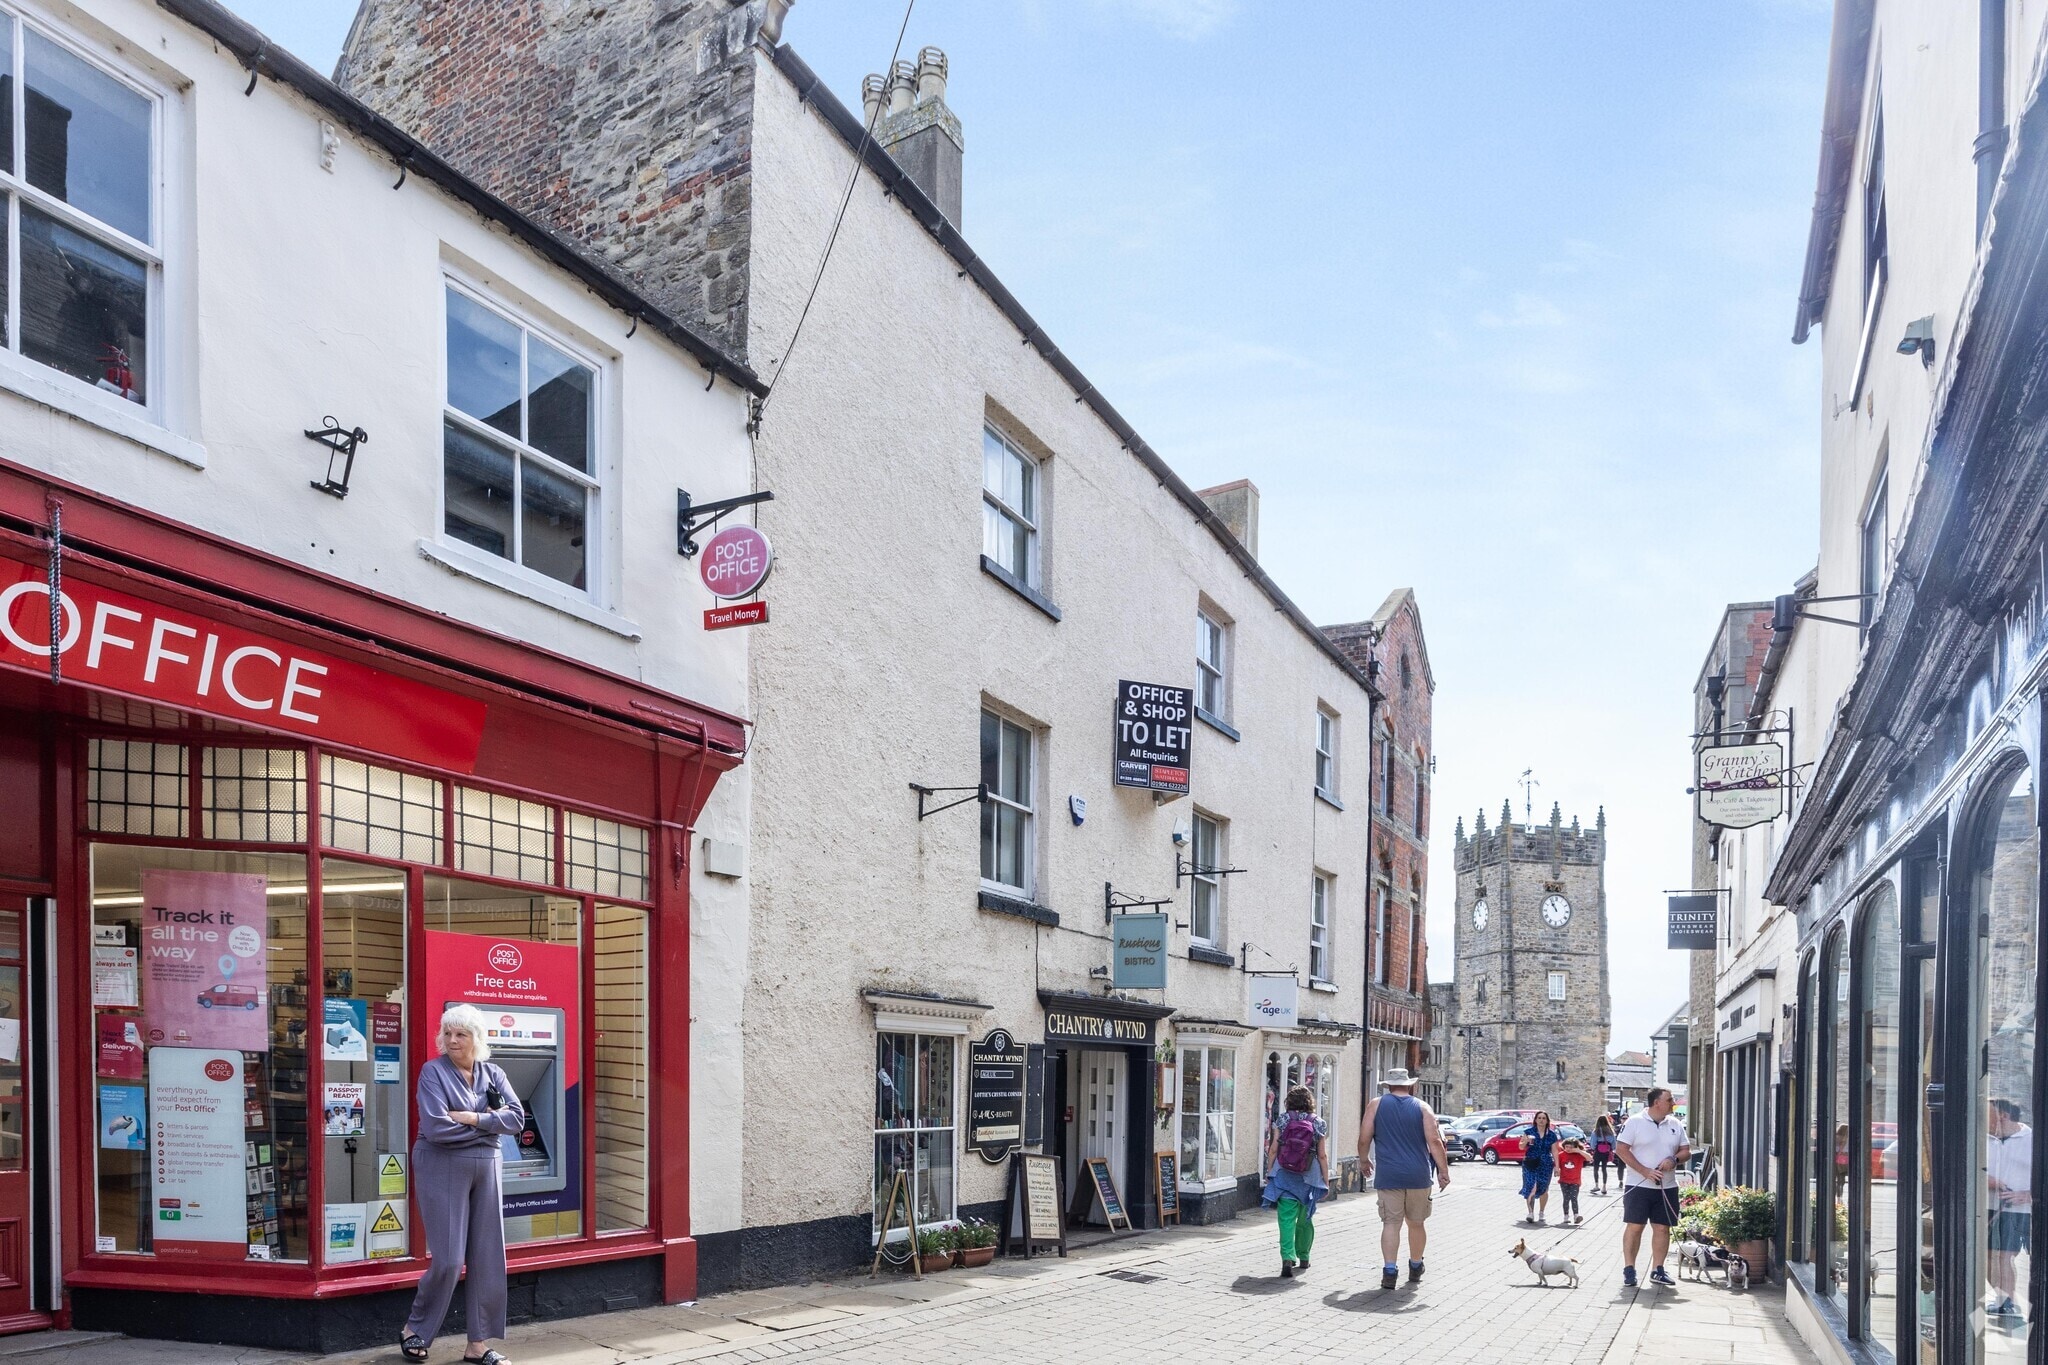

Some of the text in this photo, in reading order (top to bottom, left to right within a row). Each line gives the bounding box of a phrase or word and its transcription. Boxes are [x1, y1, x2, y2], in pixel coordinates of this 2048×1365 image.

[716, 539, 753, 562] POST
[707, 556, 759, 581] OFFICE
[710, 608, 760, 624] Travel Money
[0, 581, 328, 724] OFFICE
[1128, 684, 1184, 705] OFFICE
[1124, 700, 1186, 721] & SHOP
[1119, 720, 1190, 750] TO LET
[1130, 748, 1178, 762] All Enquiries
[1704, 750, 1770, 771] Granny's
[1721, 764, 1778, 781] Kitchen
[152, 907, 234, 925] Track it
[151, 926, 219, 942] all the
[1119, 937, 1162, 952] Rustique
[151, 946, 196, 962] way
[492, 957, 517, 966] OFFICE
[497, 950, 515, 958] POST
[1124, 957, 1155, 966] BISTRO
[476, 974, 537, 990] Free cash
[464, 990, 497, 998] withdrawals
[1263, 1007, 1280, 1016] age
[1048, 1014, 1146, 1039] CHANTRY WYND
[102, 1043, 134, 1052] delivery
[157, 1086, 192, 1095] everything
